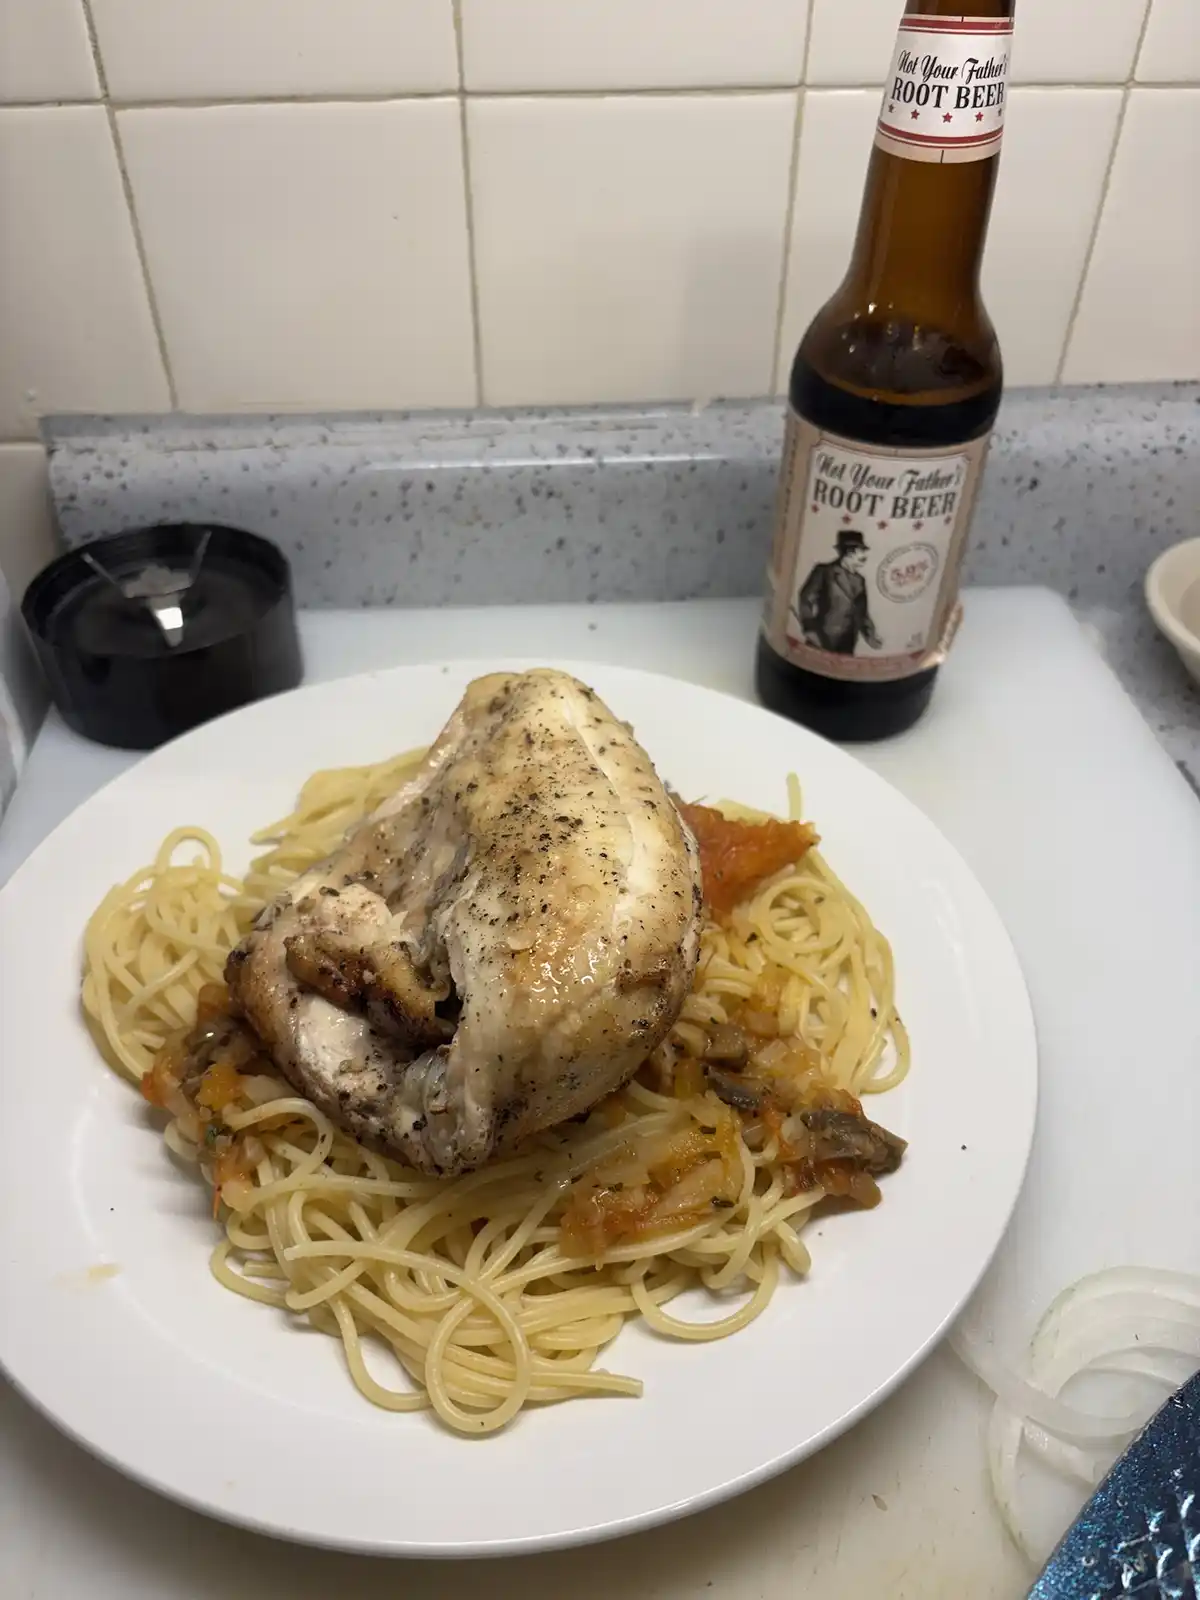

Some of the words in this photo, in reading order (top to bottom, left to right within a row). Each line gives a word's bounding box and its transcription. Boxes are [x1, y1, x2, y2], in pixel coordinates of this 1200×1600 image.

[898, 50, 919, 75] Not
[921, 54, 958, 82] Your
[891, 77, 949, 109] ROOT
[954, 82, 1005, 109] BEER
[816, 452, 847, 482] Not
[850, 464, 894, 492] Your
[813, 478, 884, 517] ROOT
[890, 491, 957, 519] BEER
